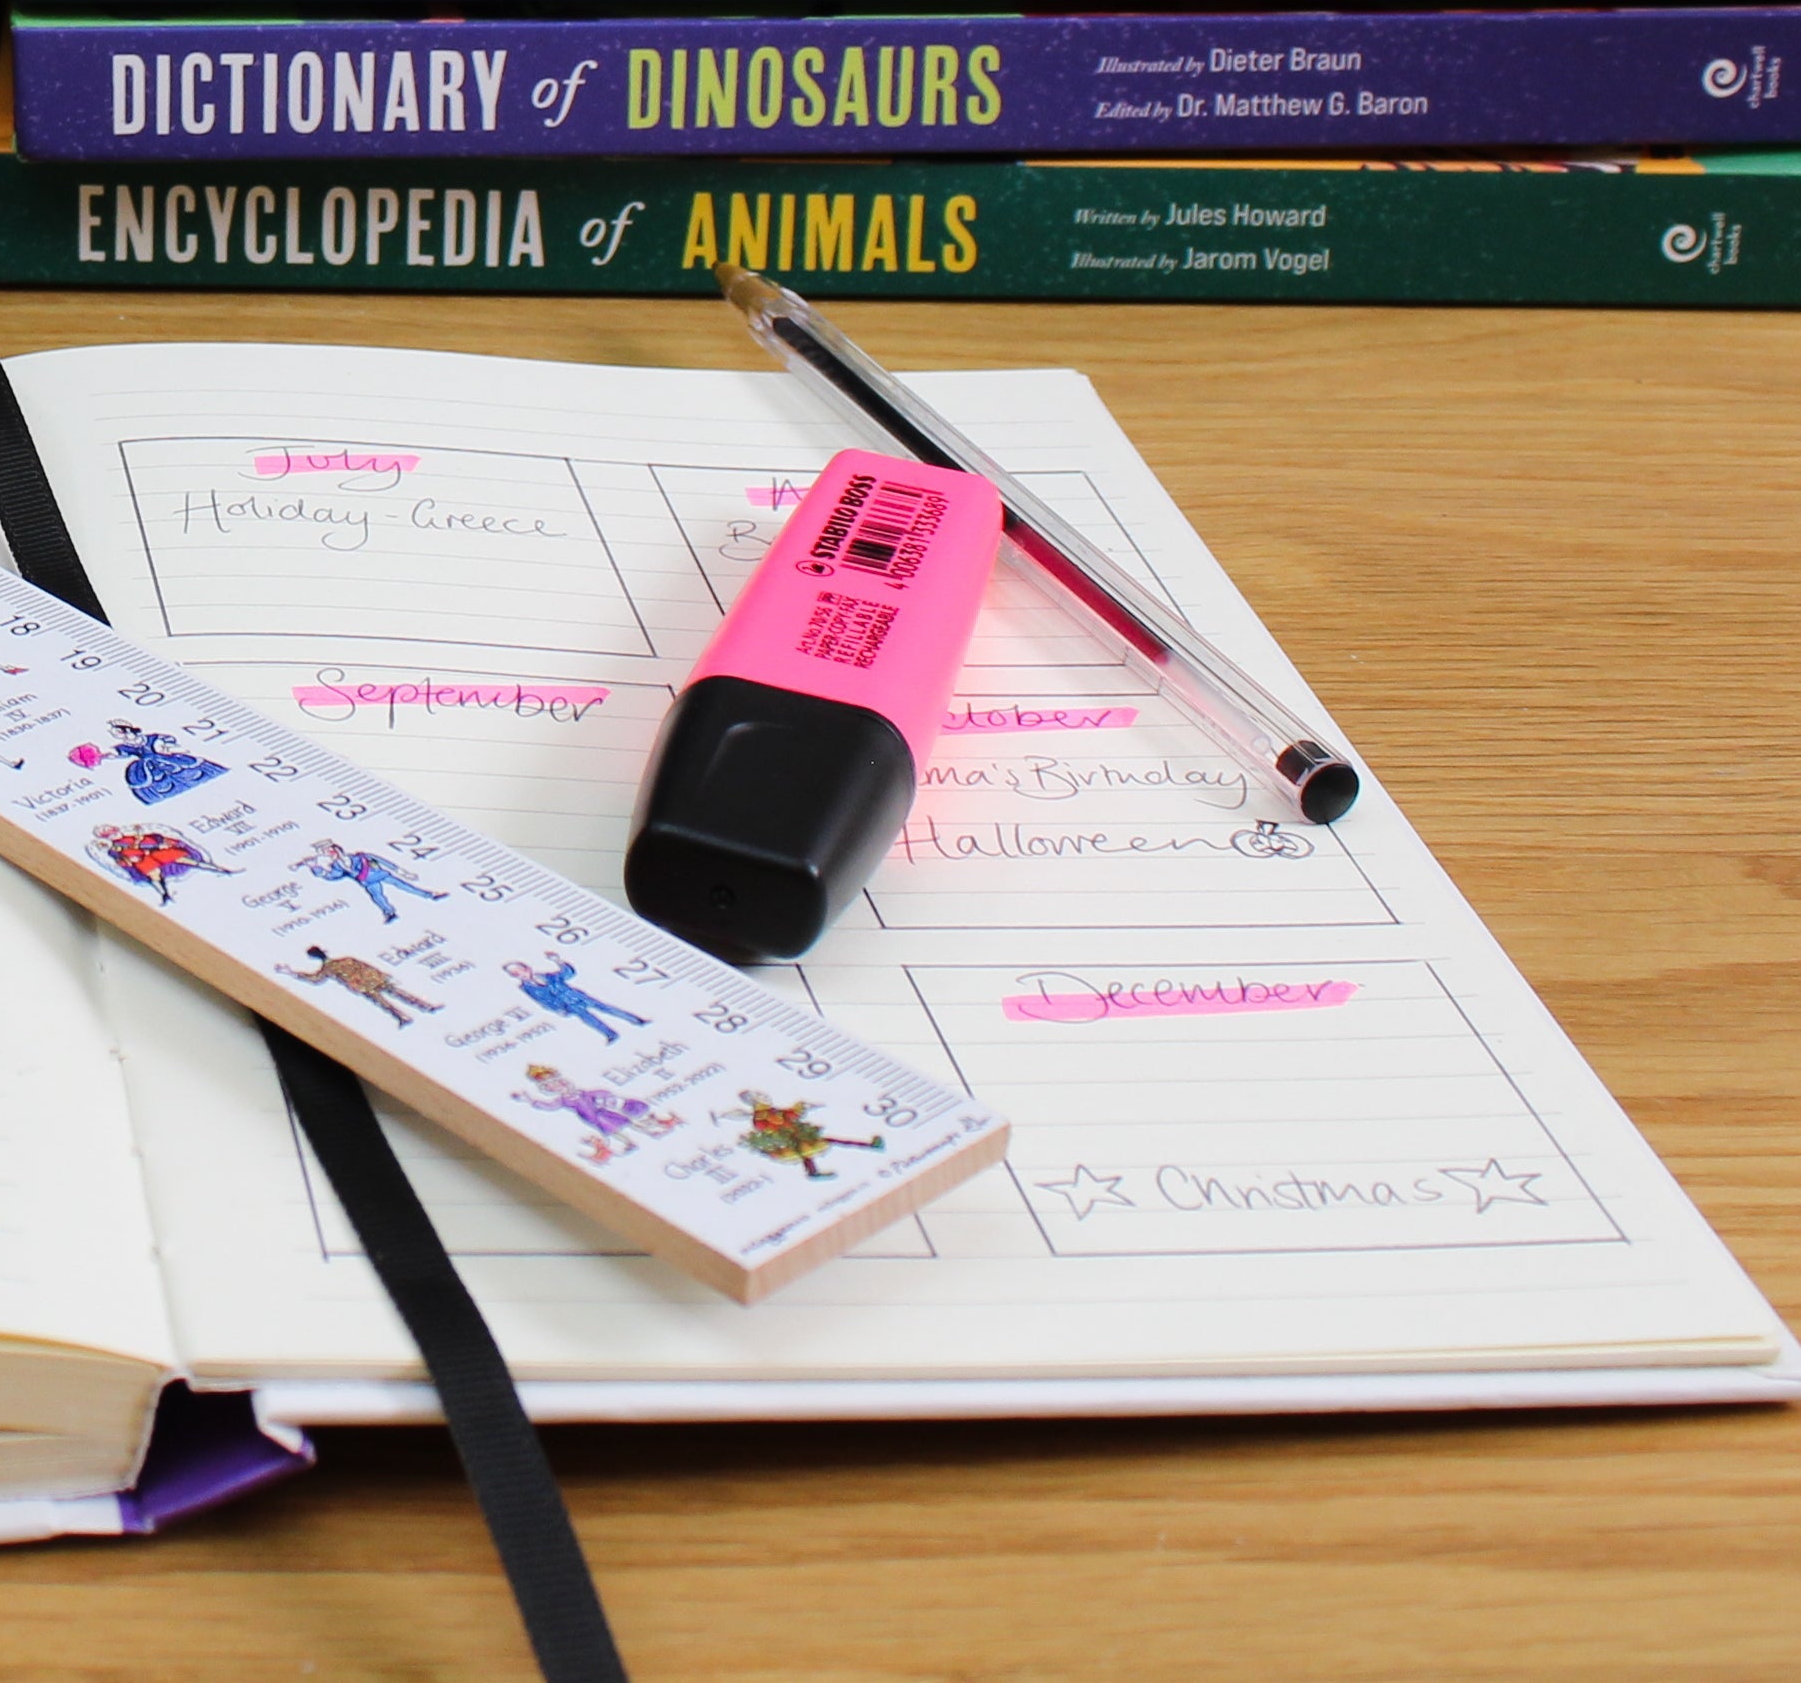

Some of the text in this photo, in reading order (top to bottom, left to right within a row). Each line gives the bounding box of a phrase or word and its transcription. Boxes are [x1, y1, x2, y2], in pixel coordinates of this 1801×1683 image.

[1096, 47, 1362, 77] Illustrated by Dieter Braun
[112, 44, 1001, 135] DICTIONARY of DINOSAURS
[1095, 91, 1429, 122] Edited by Dr. Matthew G. Baron
[77, 184, 978, 275] ENCYCLOPEDIA of ANIMALS
[1074, 202, 1327, 229] Written by Jules Howard
[1158, 252, 1178, 273] by
[1183, 247, 1257, 271] Jarom
[1262, 247, 1330, 275] Vogel
[236, 444, 403, 492] July
[174, 489, 568, 552] Holiday Greece
[810, 506, 859, 560] STABILO
[839, 473, 877, 508] BOSS
[58, 647, 103, 672] 19
[117, 682, 165, 708] 20
[297, 666, 605, 728] September
[181, 719, 230, 745] 21
[247, 756, 300, 783] 22
[1013, 755, 1248, 811] Birthday
[10, 774, 95, 811] Victoria
[317, 793, 369, 822] 23
[187, 800, 258, 834] Edward
[388, 834, 442, 862] 24
[895, 814, 1233, 865] Halloween
[240, 880, 304, 911] George
[460, 871, 516, 904] 25
[535, 916, 591, 946] 26
[376, 930, 449, 969] Edward
[612, 957, 671, 987] 27
[1015, 970, 1335, 1024] December
[443, 1015, 512, 1050] George
[692, 1000, 750, 1036] 28
[774, 1049, 834, 1081] 29
[862, 1096, 919, 1129] 30
[1156, 1164, 1444, 1211] Christmas
